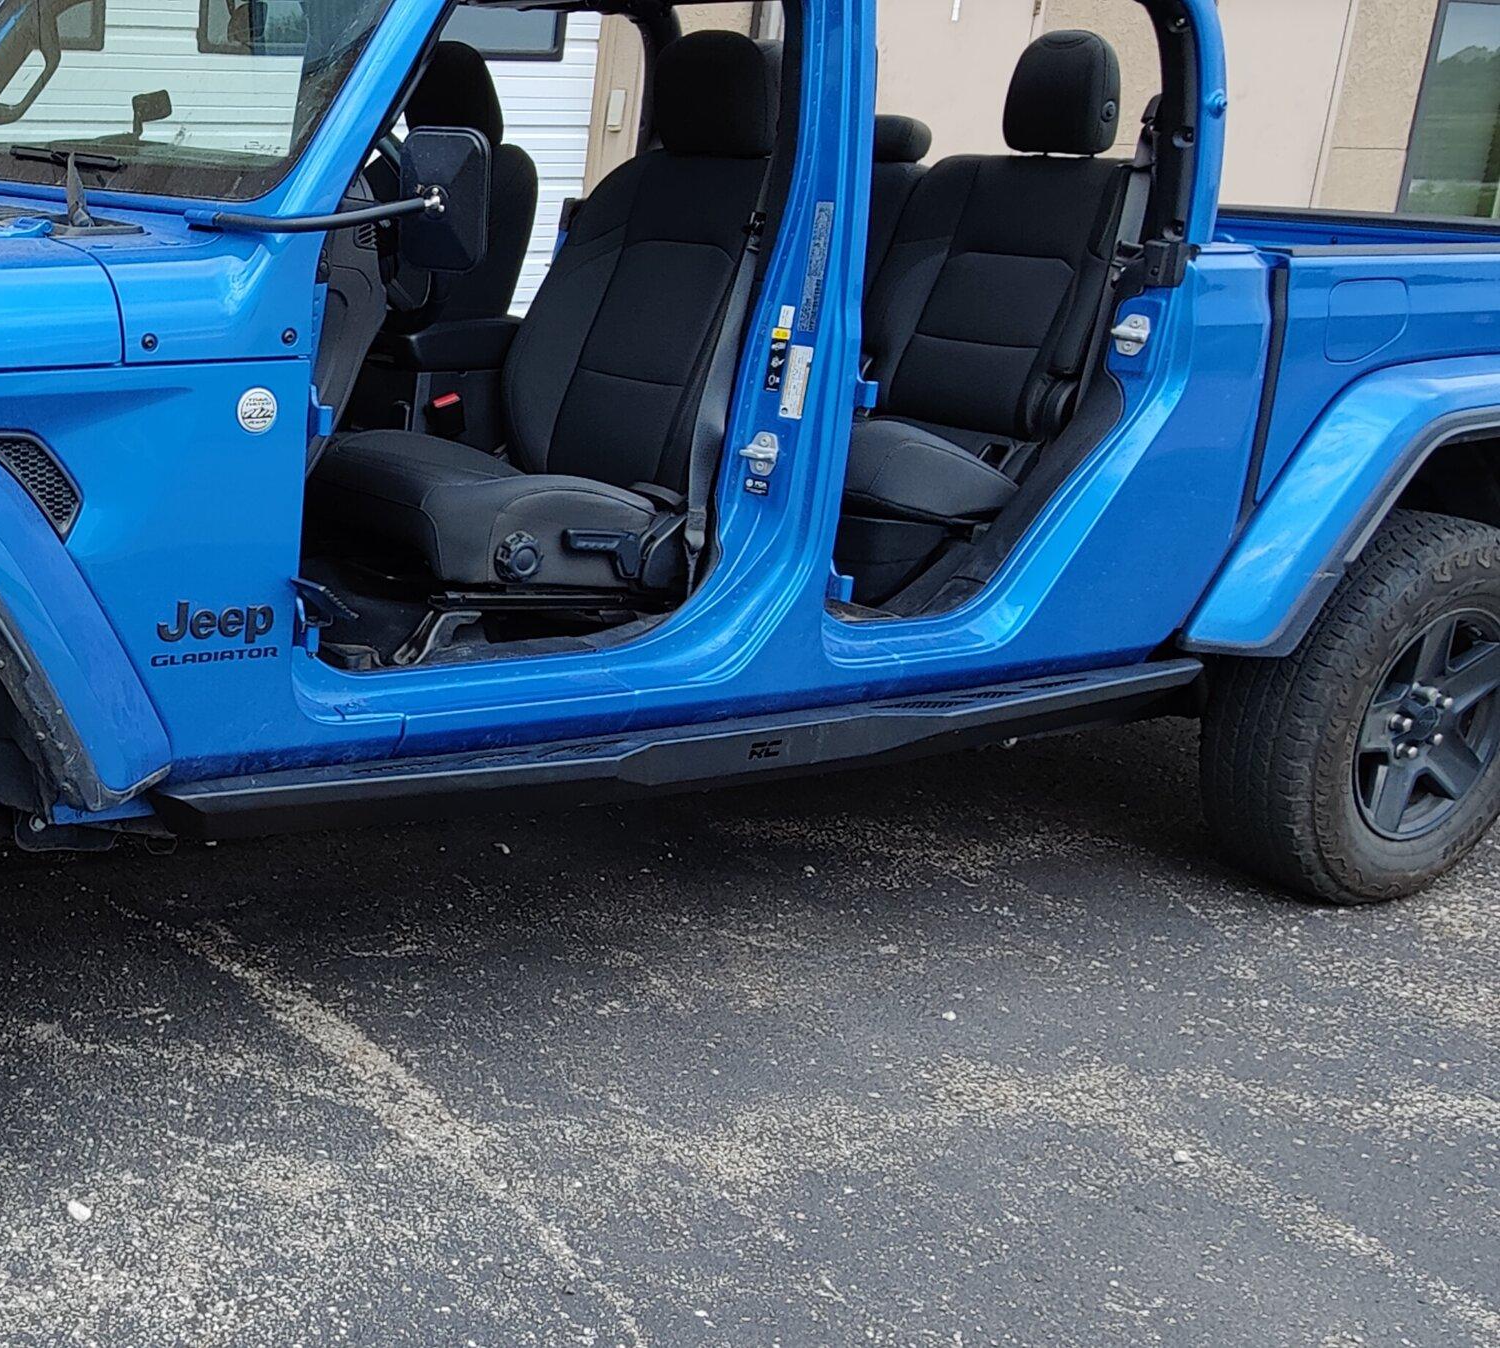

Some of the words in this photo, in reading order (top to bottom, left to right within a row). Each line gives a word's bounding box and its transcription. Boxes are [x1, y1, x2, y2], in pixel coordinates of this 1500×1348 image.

[156, 599, 275, 645] Jeep
[150, 646, 279, 668] GLADIATOR
[748, 739, 782, 760] RC
